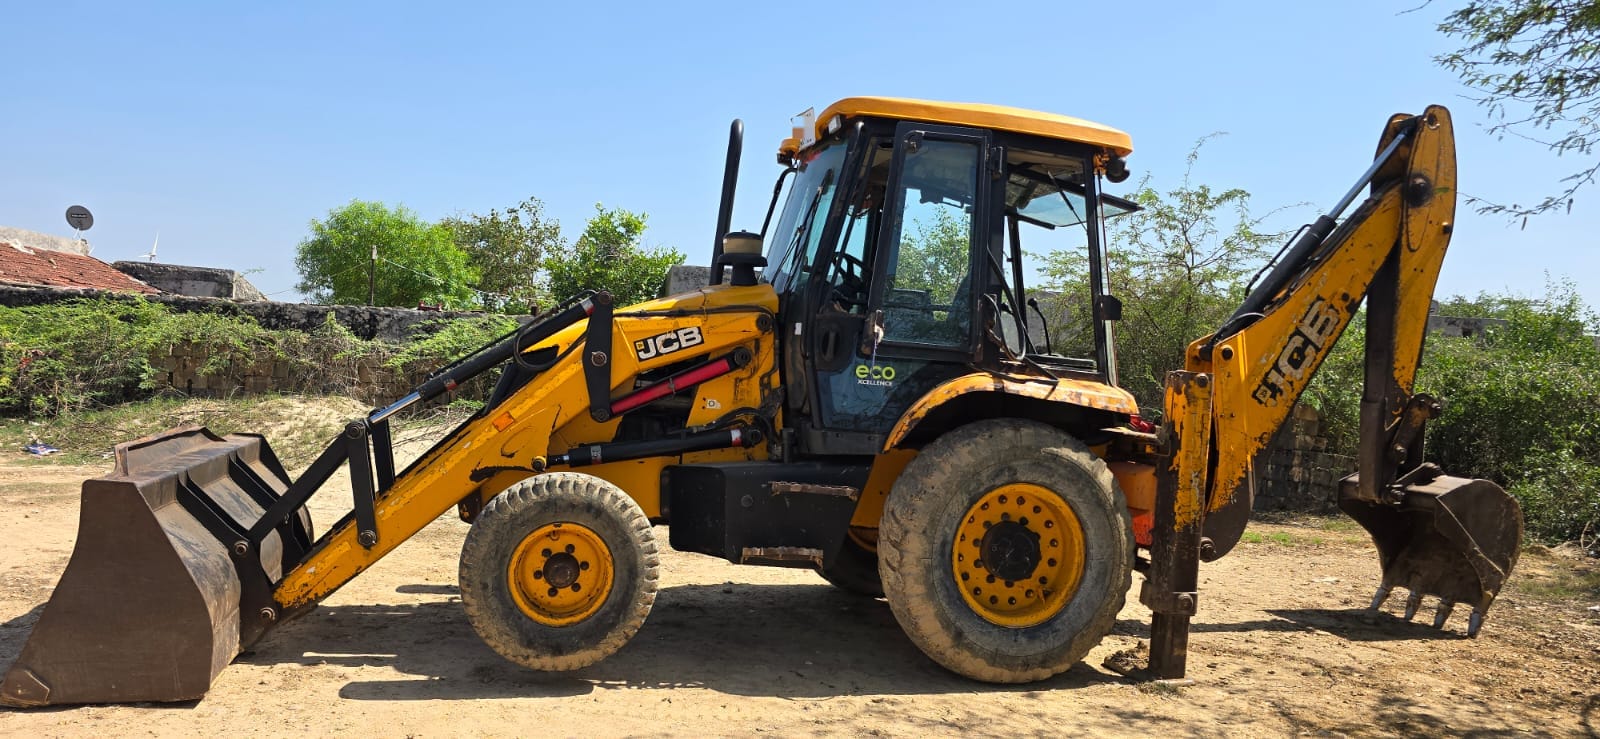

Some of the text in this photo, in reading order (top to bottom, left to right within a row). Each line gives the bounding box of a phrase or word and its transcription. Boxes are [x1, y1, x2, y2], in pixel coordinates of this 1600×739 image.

[637, 326, 703, 360] JCB
[1266, 300, 1340, 407] JCB
[855, 364, 896, 380] eco
